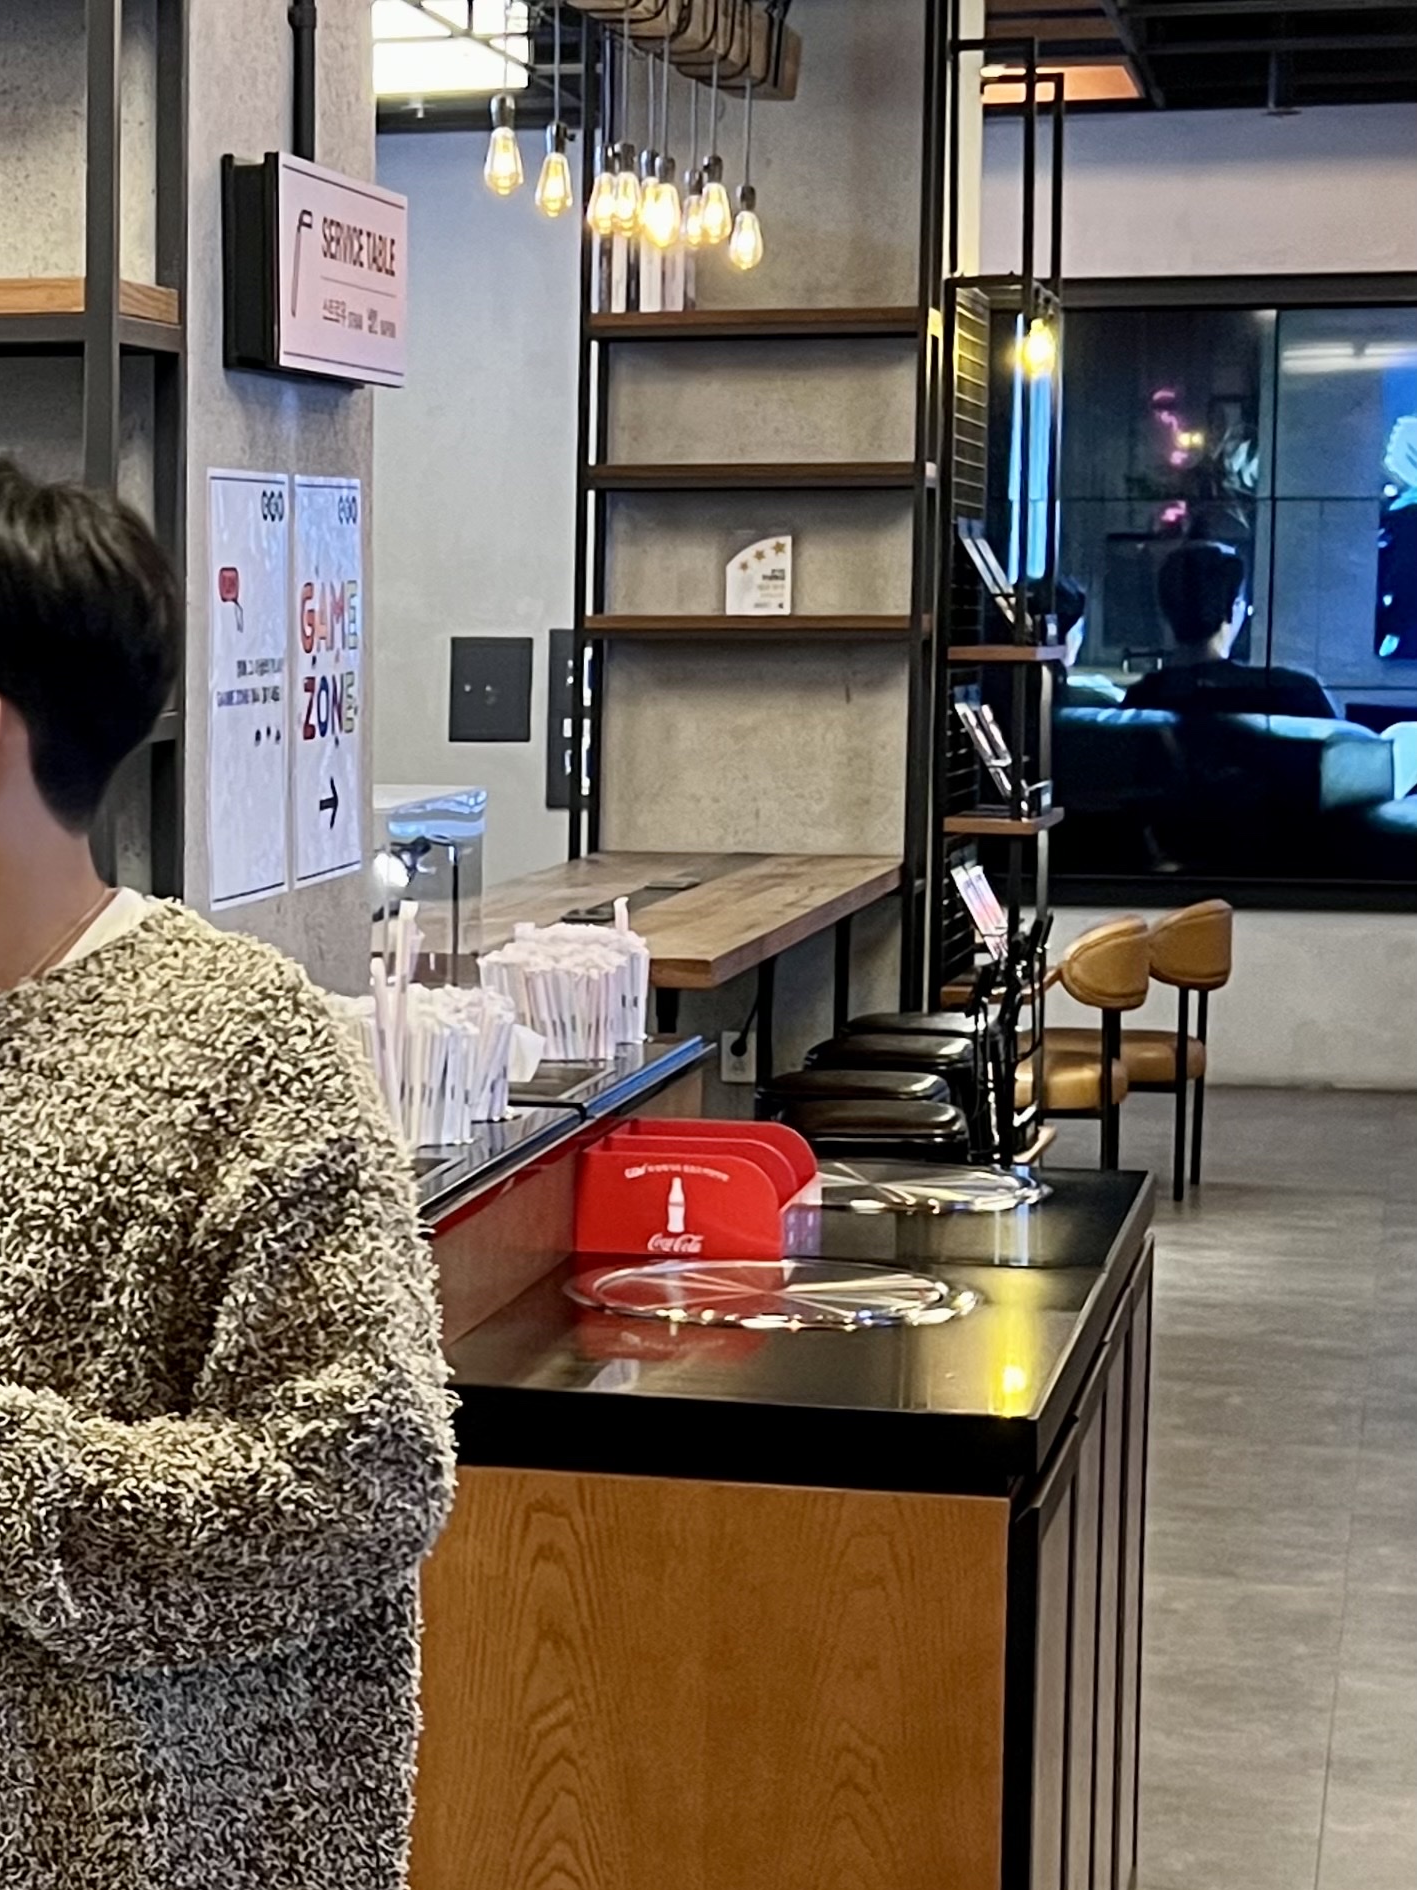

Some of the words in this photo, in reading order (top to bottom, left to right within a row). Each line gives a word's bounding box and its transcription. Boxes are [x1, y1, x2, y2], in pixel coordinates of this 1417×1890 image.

[322, 216, 363, 268] SERVICE
[367, 231, 395, 276] TABLE
[301, 580, 358, 653] GAME
[302, 671, 356, 741] ZONE
